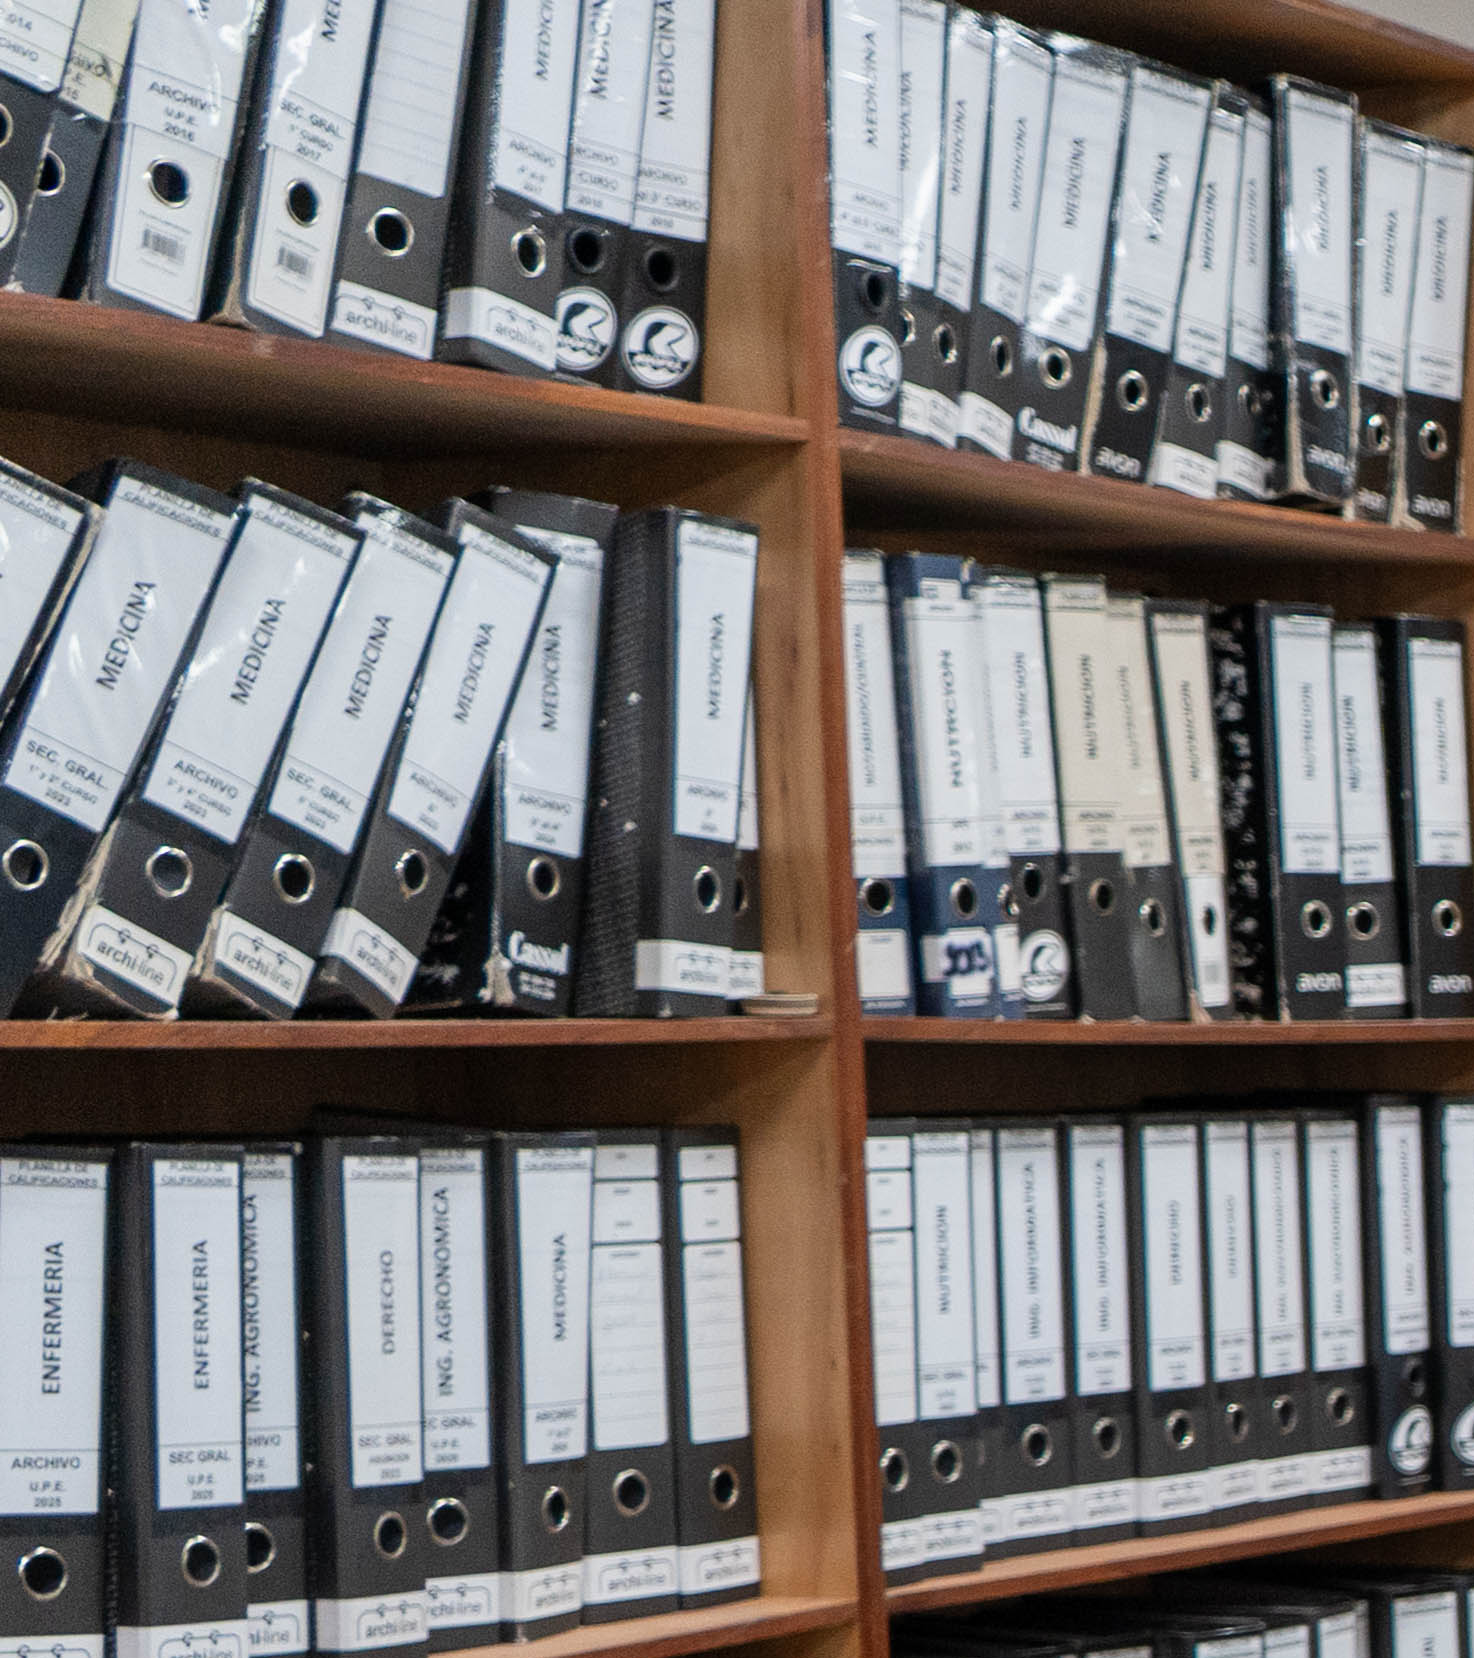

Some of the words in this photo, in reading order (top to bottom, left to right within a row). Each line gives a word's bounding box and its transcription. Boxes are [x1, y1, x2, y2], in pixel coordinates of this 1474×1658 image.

[96, 580, 156, 690] MEDICINA
[230, 598, 286, 706] MEDICINA
[345, 614, 392, 720] MEDICINA
[454, 621, 496, 725] MEDICINA
[541, 624, 562, 733] MEDICINA
[706, 612, 726, 720] MEDICINA
[172, 759, 240, 800] ARCHIVO
[96, 938, 165, 987] archi-line
[232, 948, 294, 992] archi-line
[41, 1241, 65, 1395] ENFERMERIA
[193, 1239, 209, 1392] ENFERMERIA
[380, 1249, 396, 1356] DERECHO
[434, 1187, 449, 1344] AGRONOMICA
[553, 1232, 567, 1342] MEDICINA
[246, 1357, 263, 1414] ING.
[439, 1353, 454, 1398] ING.
[11, 1456, 81, 1470] ARCHIVO
[199, 1449, 232, 1463] GRAL
